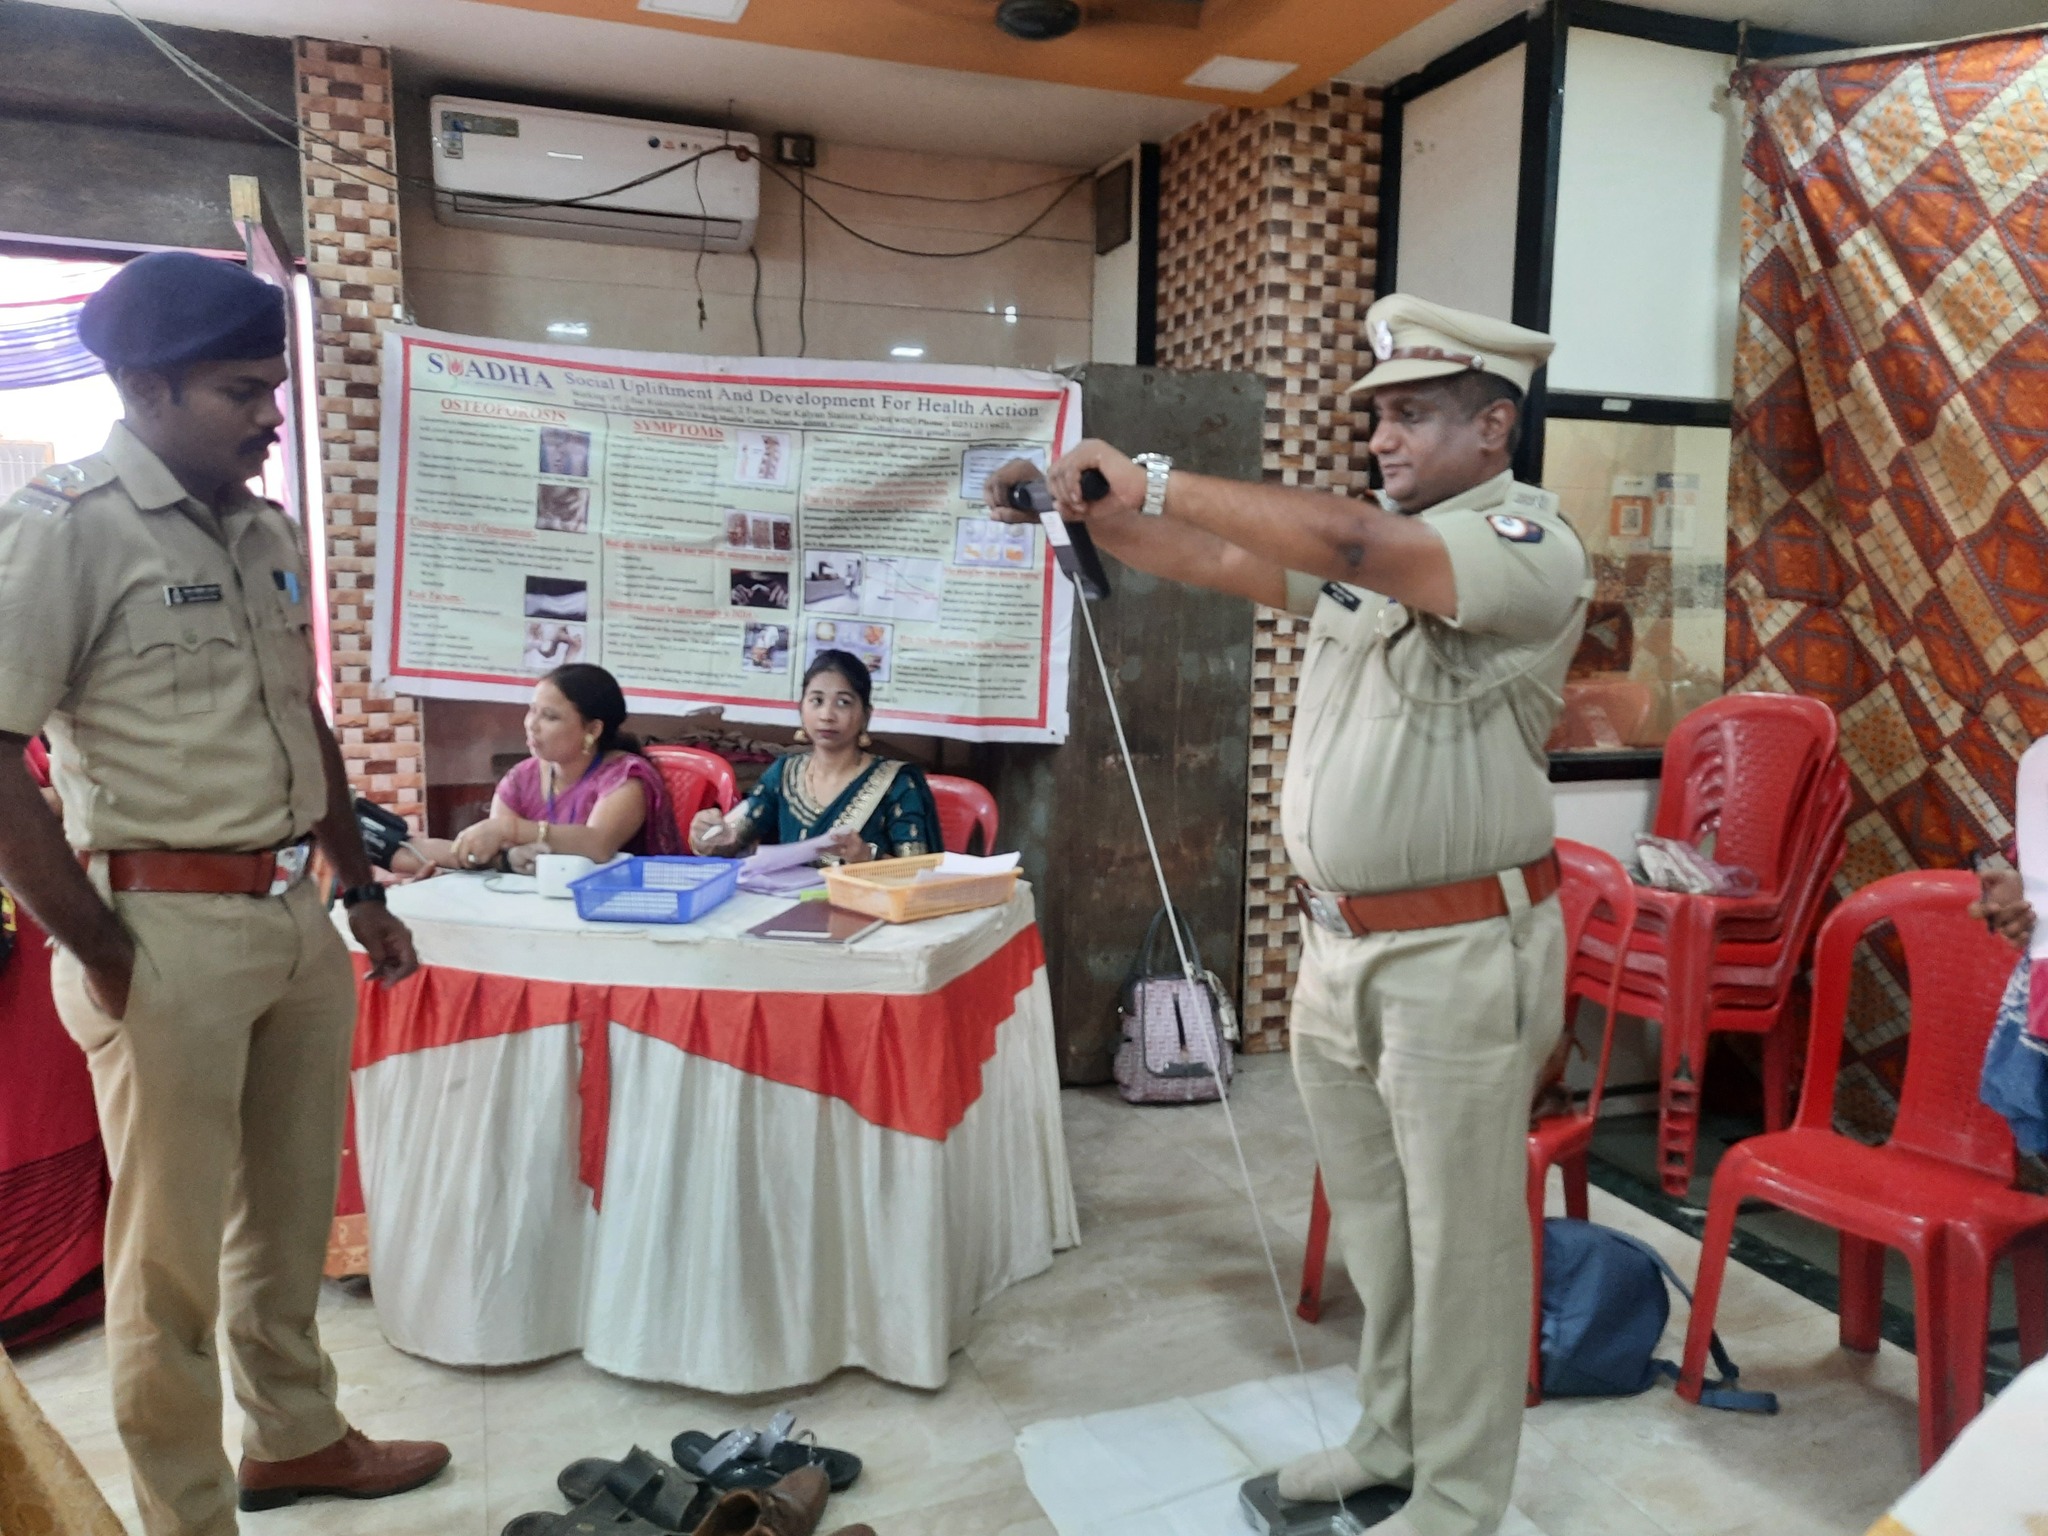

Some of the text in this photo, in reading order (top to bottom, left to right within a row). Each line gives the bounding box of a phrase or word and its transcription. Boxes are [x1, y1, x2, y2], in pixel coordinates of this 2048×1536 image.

[564, 371, 616, 390] Social
[620, 378, 713, 400] Upliftment
[717, 387, 754, 401] And
[759, 389, 875, 410] Development
[881, 394, 912, 411] For
[917, 397, 975, 415] Health
[979, 401, 1040, 417] Action
[633, 418, 725, 438] SYMPTOMS
